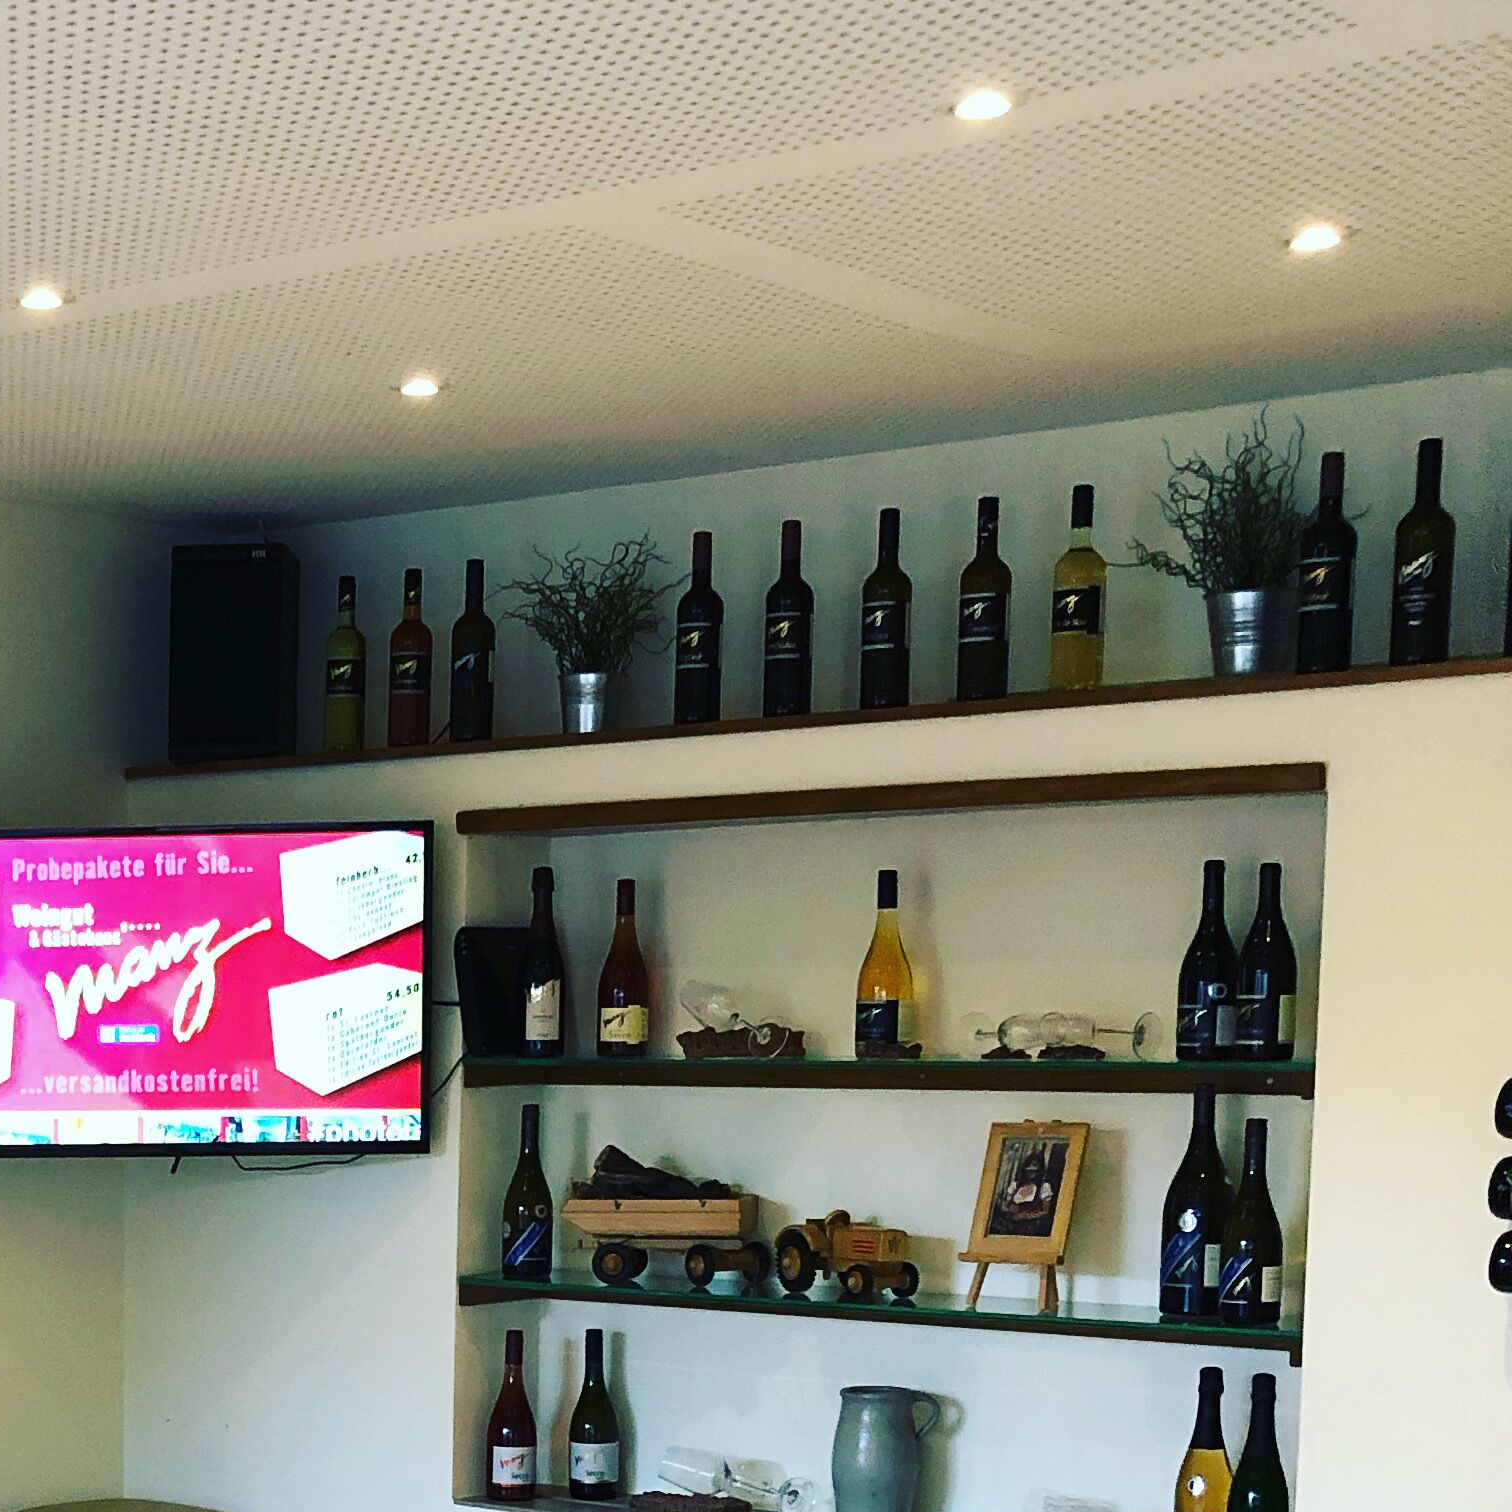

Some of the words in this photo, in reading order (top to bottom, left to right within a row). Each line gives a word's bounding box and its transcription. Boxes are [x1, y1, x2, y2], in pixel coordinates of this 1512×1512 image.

[11, 855, 145, 886] Probepakete
[154, 852, 187, 877] für
[196, 850, 254, 875] Sie...
[386, 982, 420, 1002] 54.50
[19, 1067, 260, 1095] ...versandkostenfrei!
